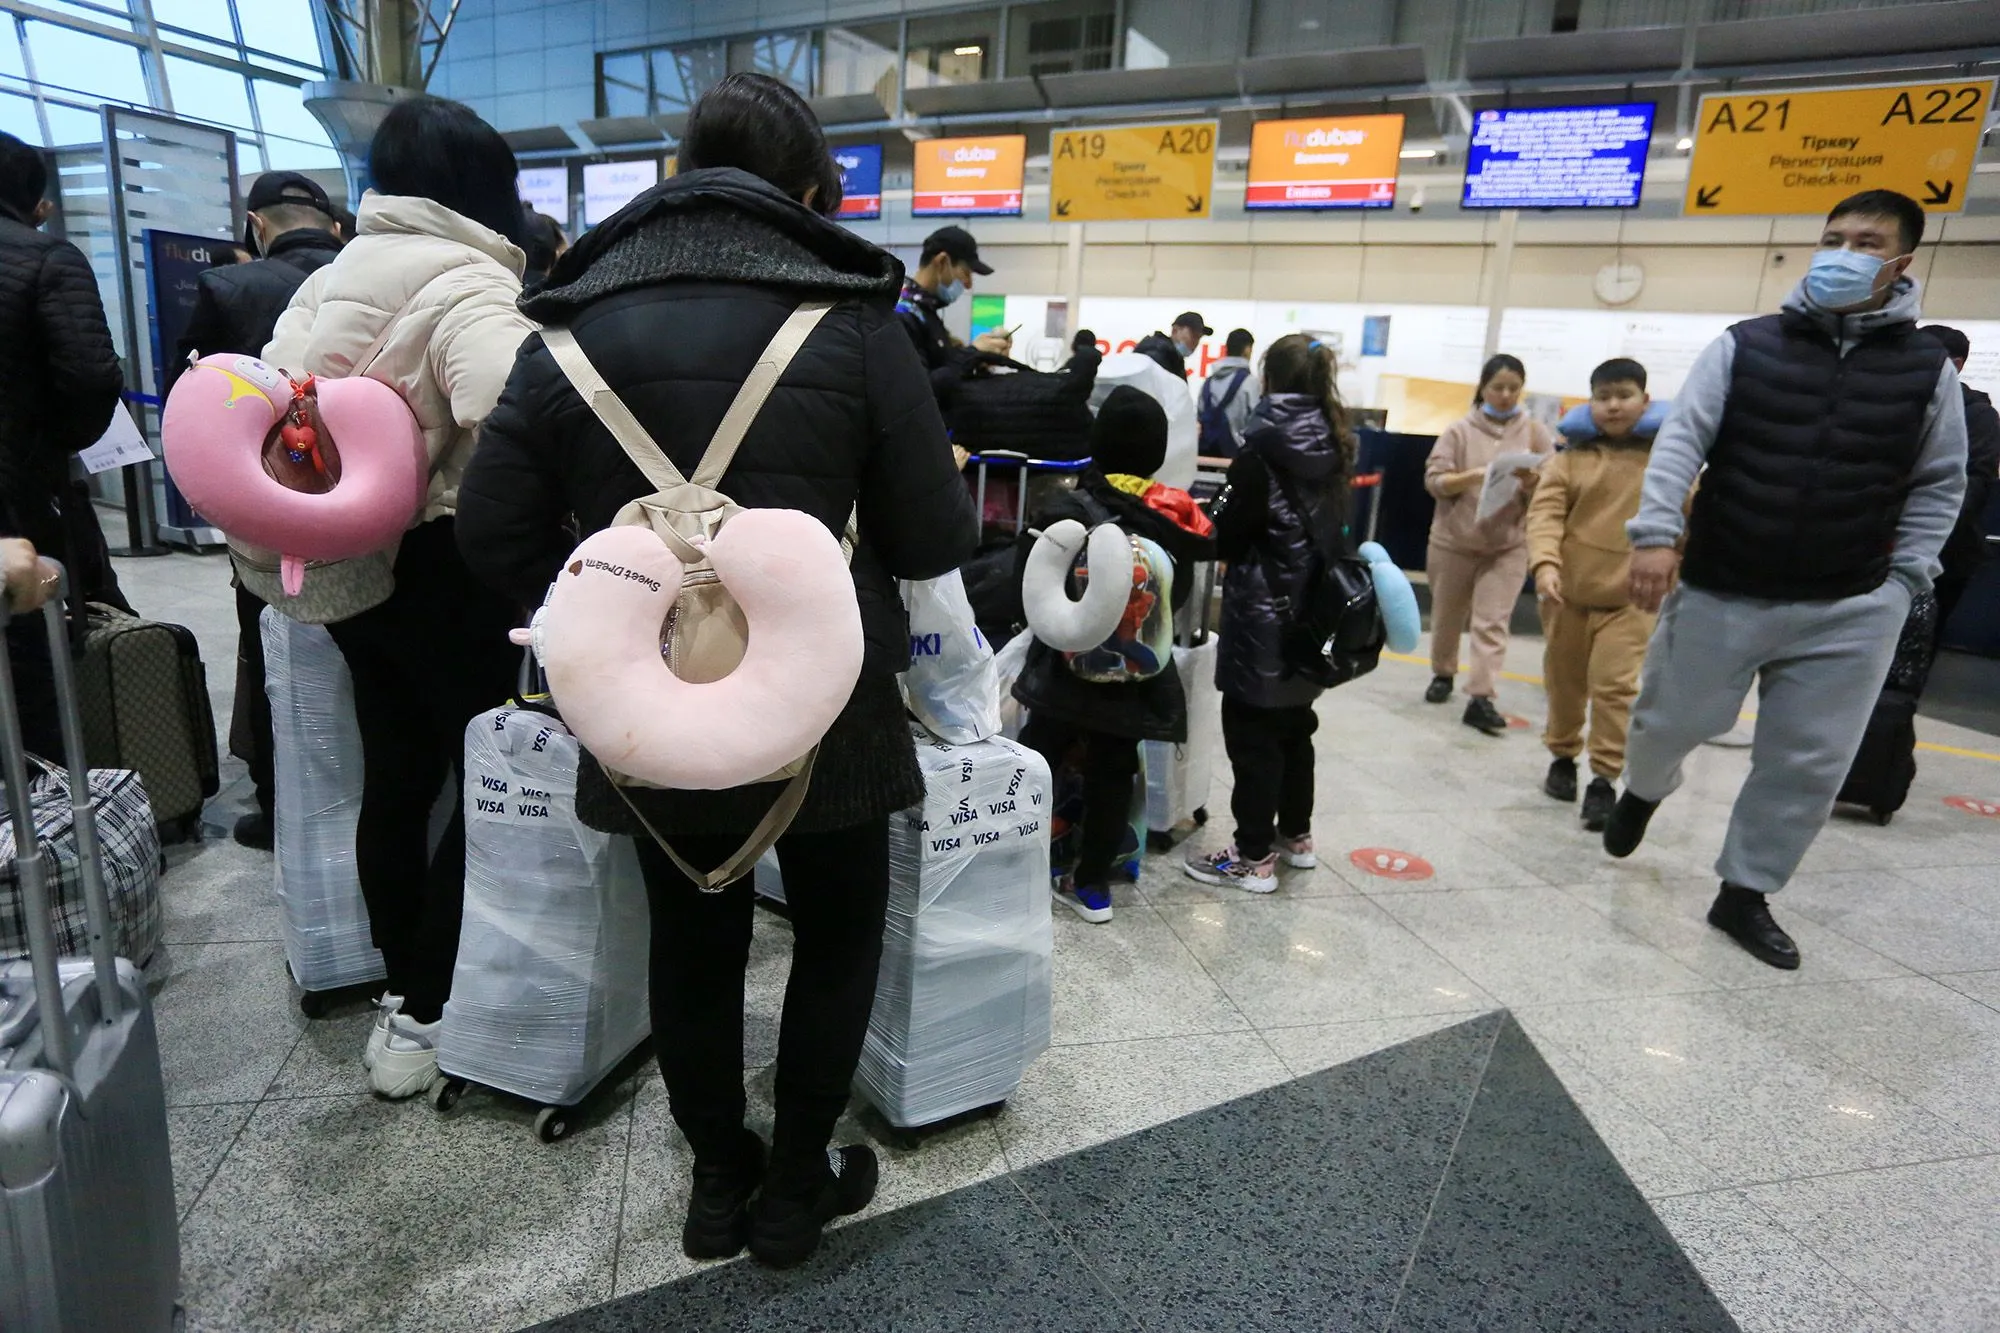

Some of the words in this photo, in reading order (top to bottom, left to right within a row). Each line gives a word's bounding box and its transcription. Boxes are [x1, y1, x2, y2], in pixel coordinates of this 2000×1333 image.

[1881, 87, 1982, 126] A22
[1707, 99, 1791, 134] A21
[1056, 133, 1106, 160] A19
[1158, 127, 1213, 155] A20
[1800, 135, 1860, 151] Тіркеу
[1769, 154, 1884, 170] Регистрация
[1783, 172, 1861, 188] Check-in
[585, 558, 625, 577] Dream
[624, 569, 662, 592] Sweet
[960, 756, 973, 783] VISA
[480, 775, 508, 794] VISA
[1006, 767, 1027, 797] VISA
[476, 798, 505, 815] VISA
[517, 803, 549, 818] VISA
[988, 799, 1016, 816] VISA
[949, 808, 979, 826] VISA
[1017, 821, 1039, 837] VISA
[931, 837, 961, 852] VISA
[972, 831, 1000, 846] VISA
